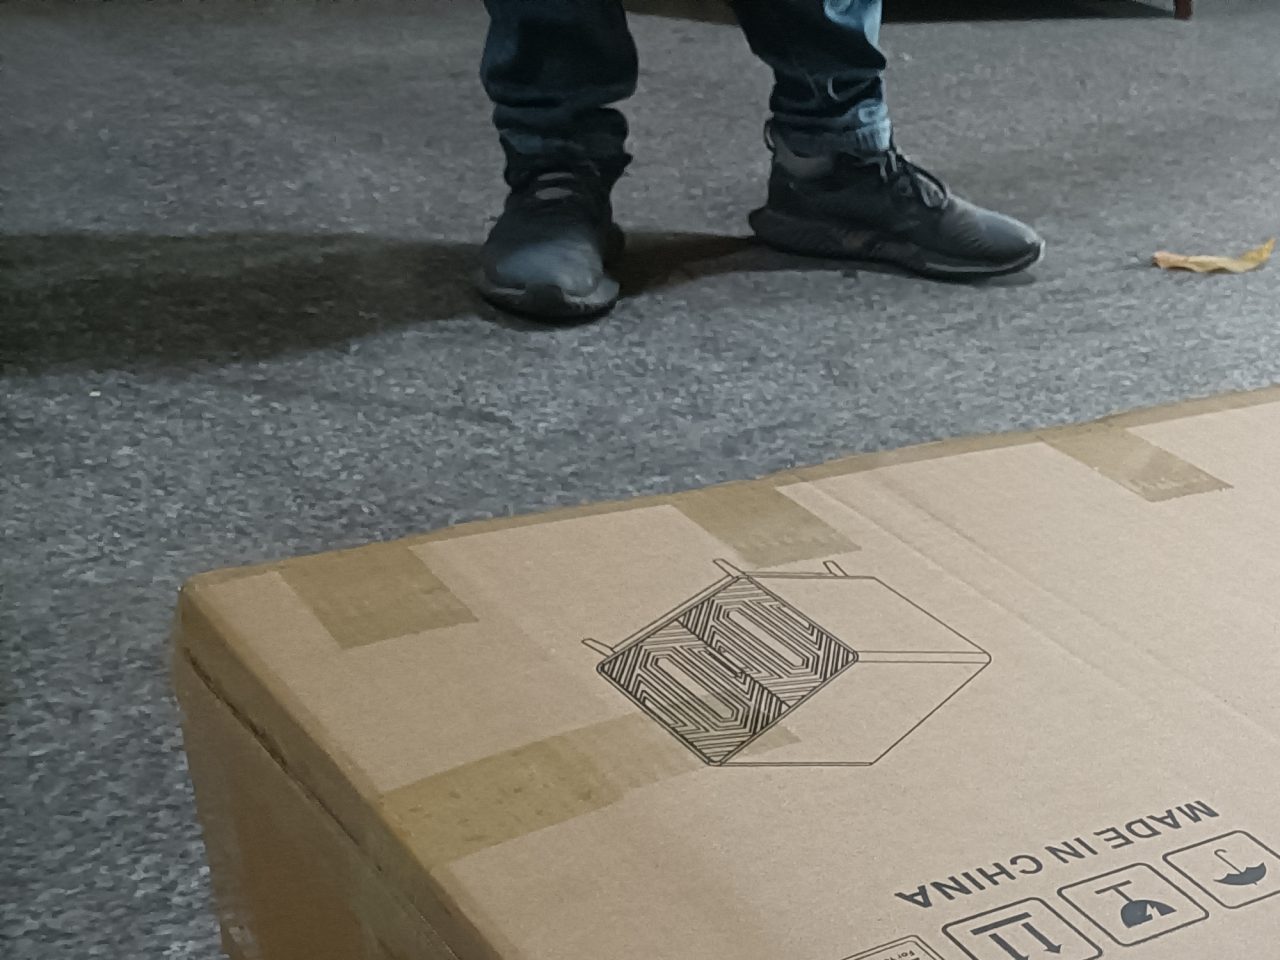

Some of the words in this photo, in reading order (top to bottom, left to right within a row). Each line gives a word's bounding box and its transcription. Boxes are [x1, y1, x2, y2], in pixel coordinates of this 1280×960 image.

[1093, 800, 1220, 849] MADE
[1044, 837, 1099, 864] IN
[894, 854, 1043, 908] CHINA
[898, 950, 916, 960] For
